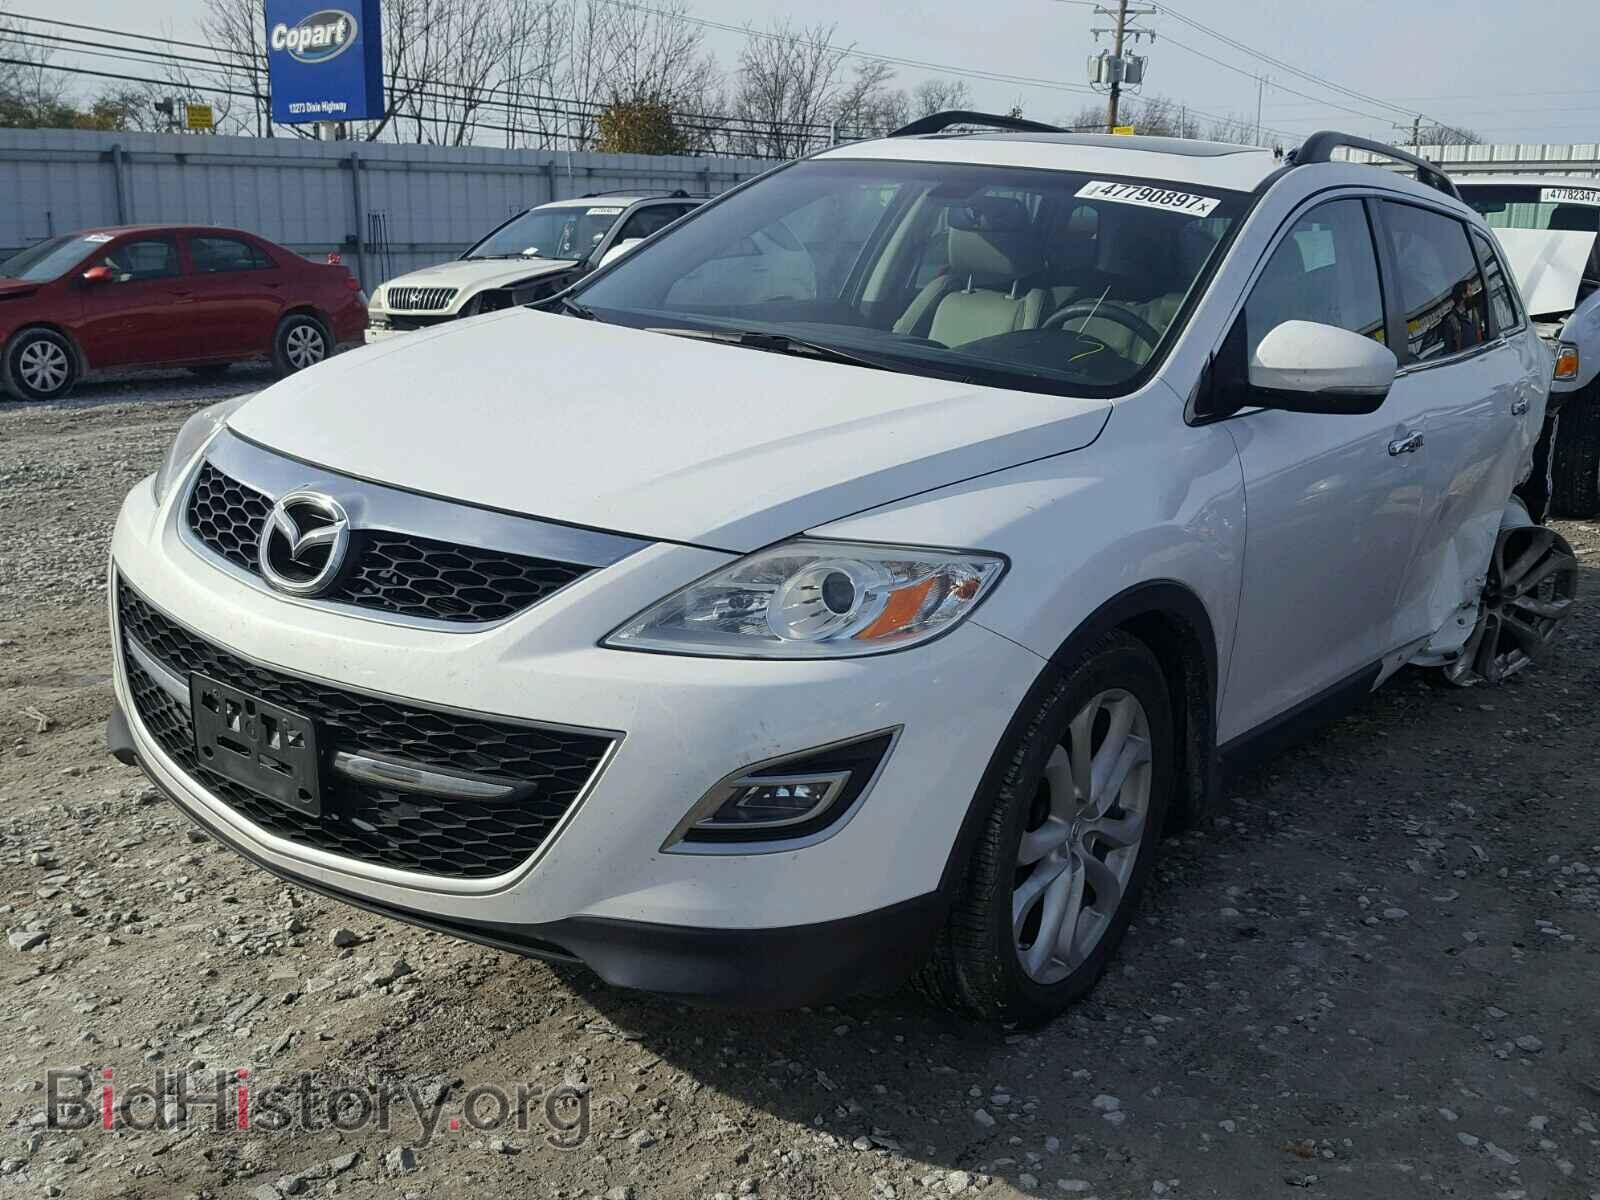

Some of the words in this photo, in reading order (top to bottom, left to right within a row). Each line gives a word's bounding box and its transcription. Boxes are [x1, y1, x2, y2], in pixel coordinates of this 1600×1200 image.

[272, 15, 347, 54] Copart
[306, 102, 320, 113] Dixie
[321, 101, 347, 114] Highway
